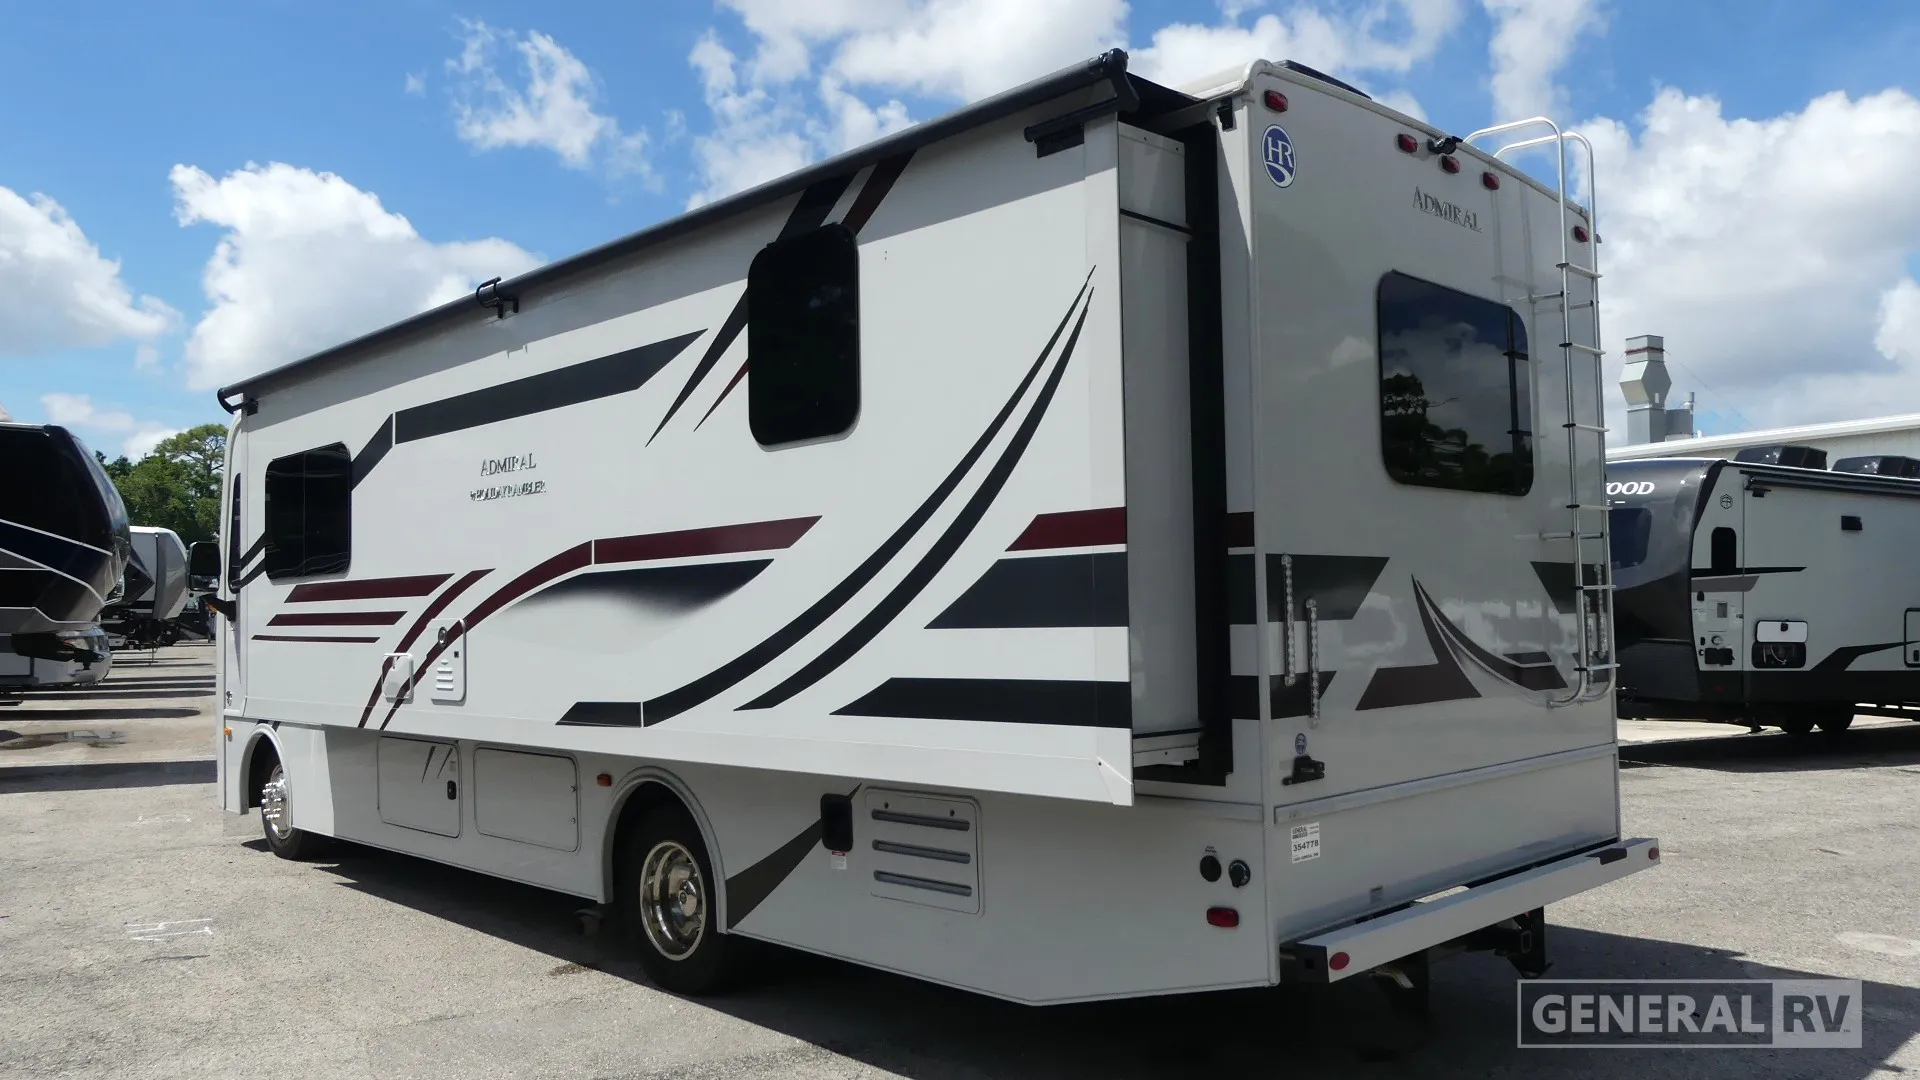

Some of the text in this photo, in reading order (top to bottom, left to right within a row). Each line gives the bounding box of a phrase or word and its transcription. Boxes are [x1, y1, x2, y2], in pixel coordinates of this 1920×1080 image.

[1267, 136, 1294, 168] HR
[1412, 185, 1483, 233] ADMIRAL
[480, 452, 537, 477] ADMIRAL
[1606, 481, 1655, 495] OOD
[1293, 839, 1319, 852] 354778
